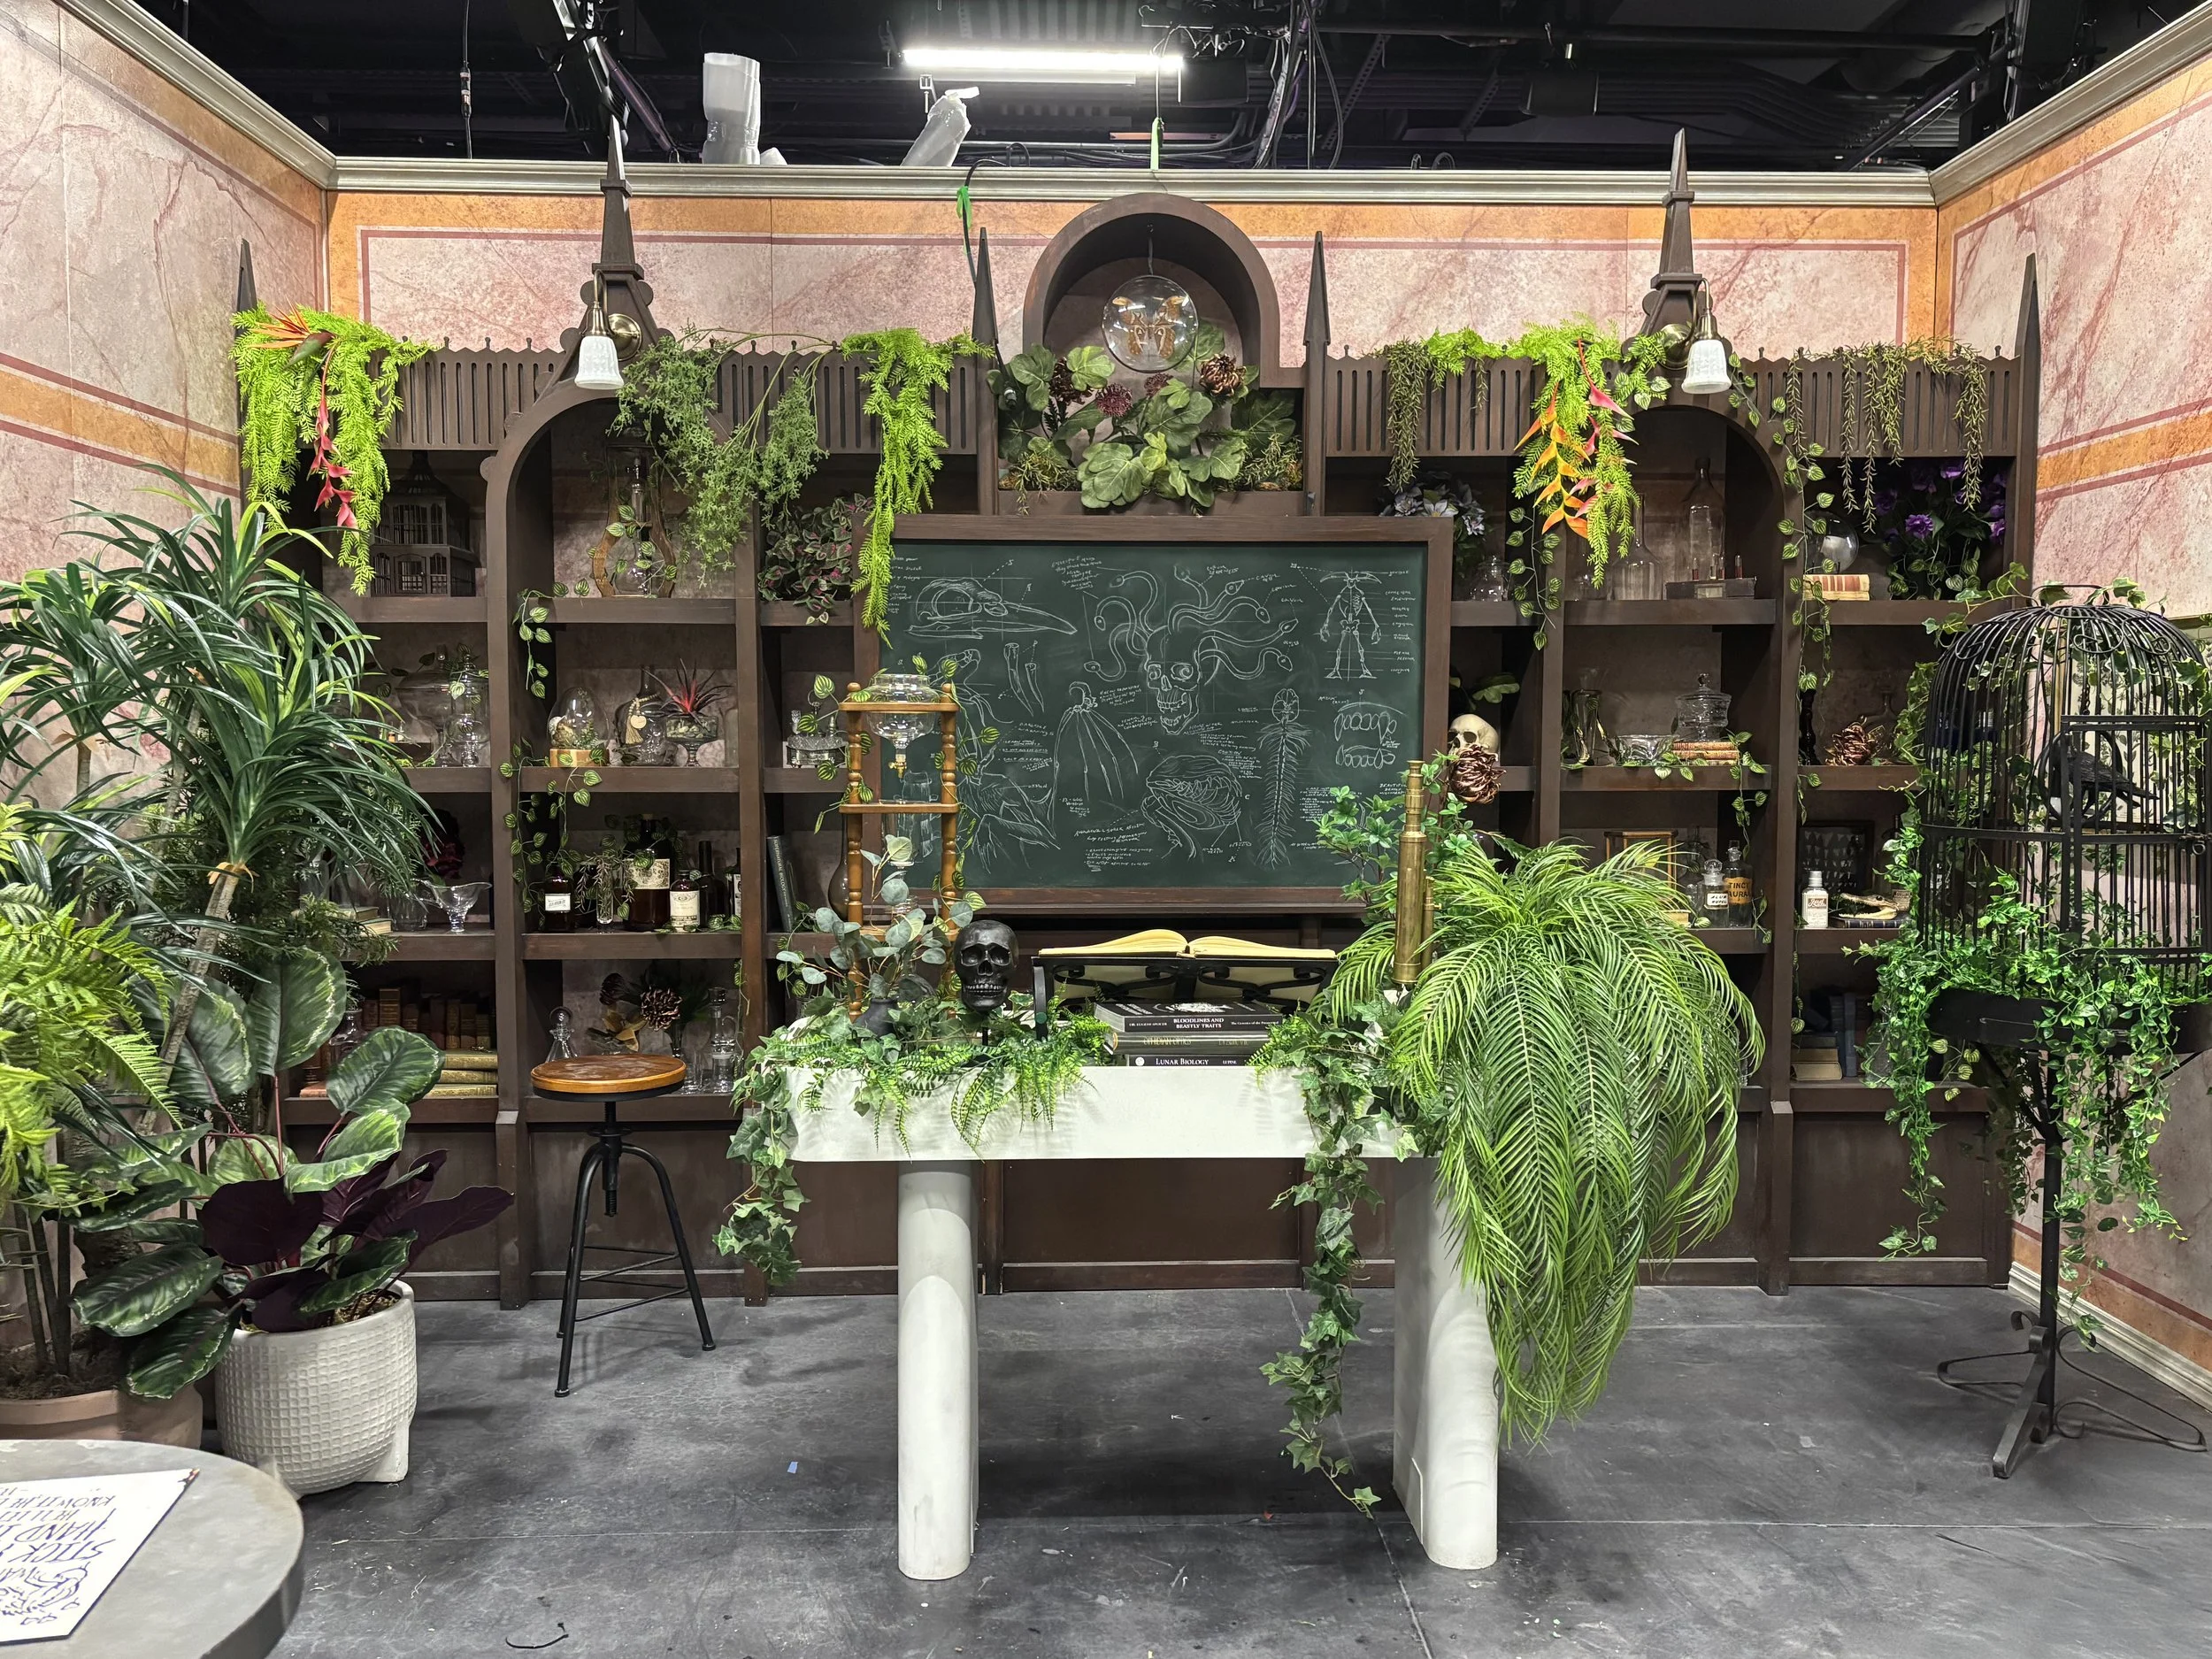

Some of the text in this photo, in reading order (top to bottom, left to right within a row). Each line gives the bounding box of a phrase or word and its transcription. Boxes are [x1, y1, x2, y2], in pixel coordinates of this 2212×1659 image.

[61, 1495, 116, 1509] KNOW
[14, 1509, 116, 1542] HAND
[7, 1540, 116, 1563] STICK
